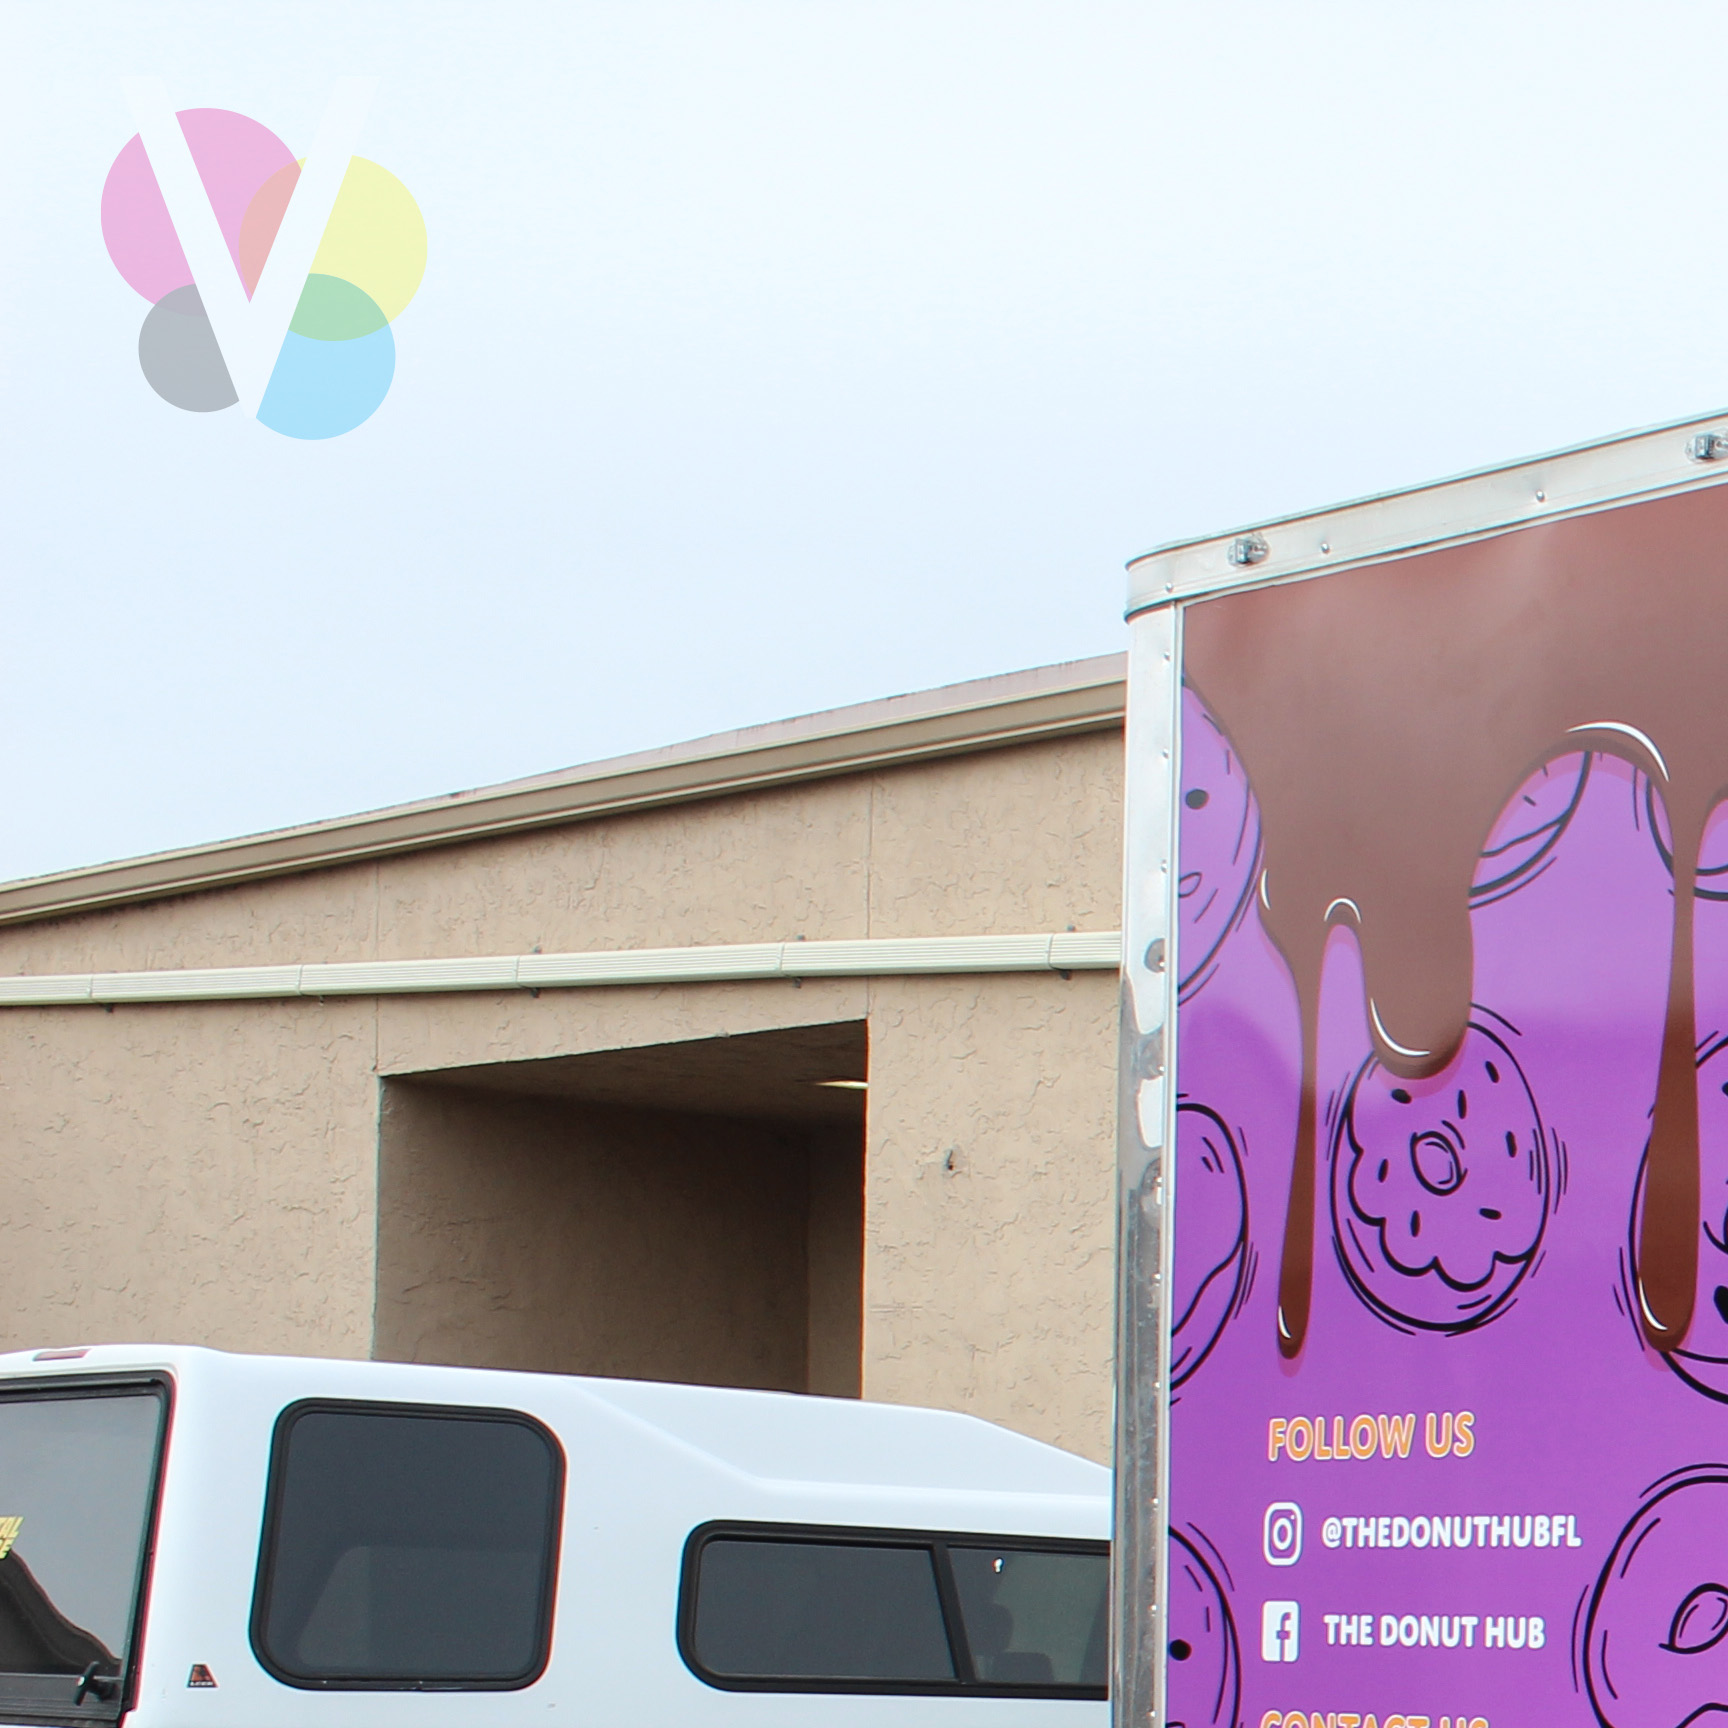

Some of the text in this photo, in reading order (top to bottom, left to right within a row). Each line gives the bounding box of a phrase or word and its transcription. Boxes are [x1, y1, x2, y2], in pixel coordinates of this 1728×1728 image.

[1267, 1411, 1475, 1462] FOLLOW US
[1322, 1514, 1581, 1548] @THEDONUTHUBFL
[1323, 1614, 1546, 1649] THE DONUT HUB
